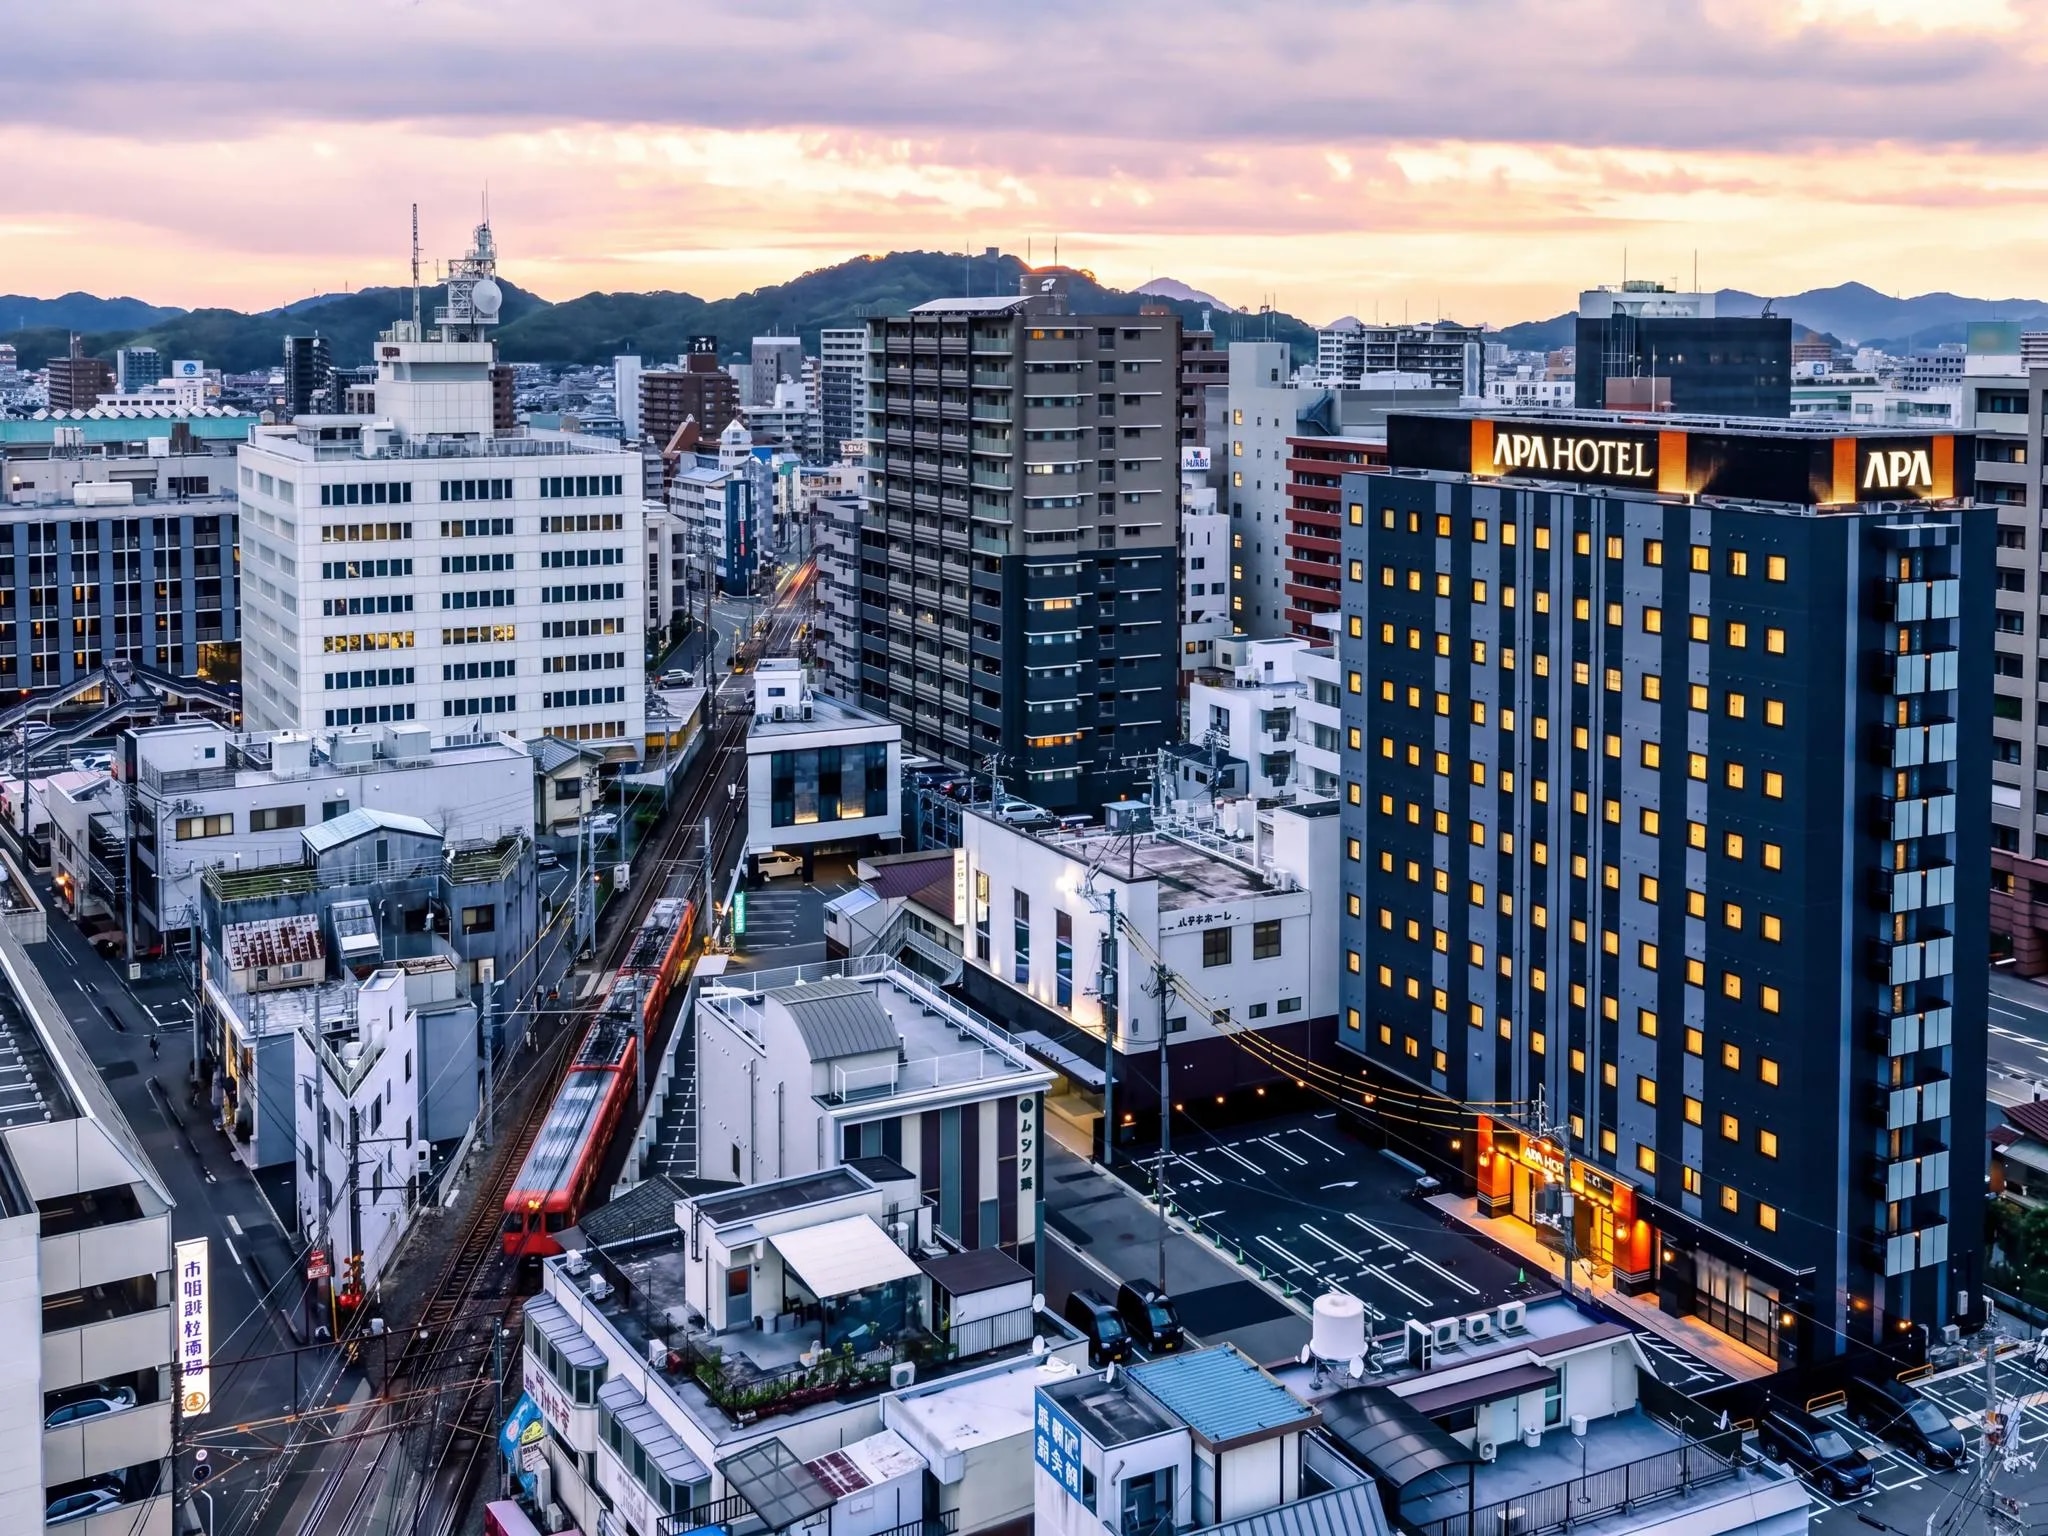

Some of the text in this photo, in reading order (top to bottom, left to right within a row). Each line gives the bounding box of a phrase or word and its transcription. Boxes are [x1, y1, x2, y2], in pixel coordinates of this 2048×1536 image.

[1493, 433, 1654, 477] APA HOTEL
[1863, 450, 1932, 488] APA
